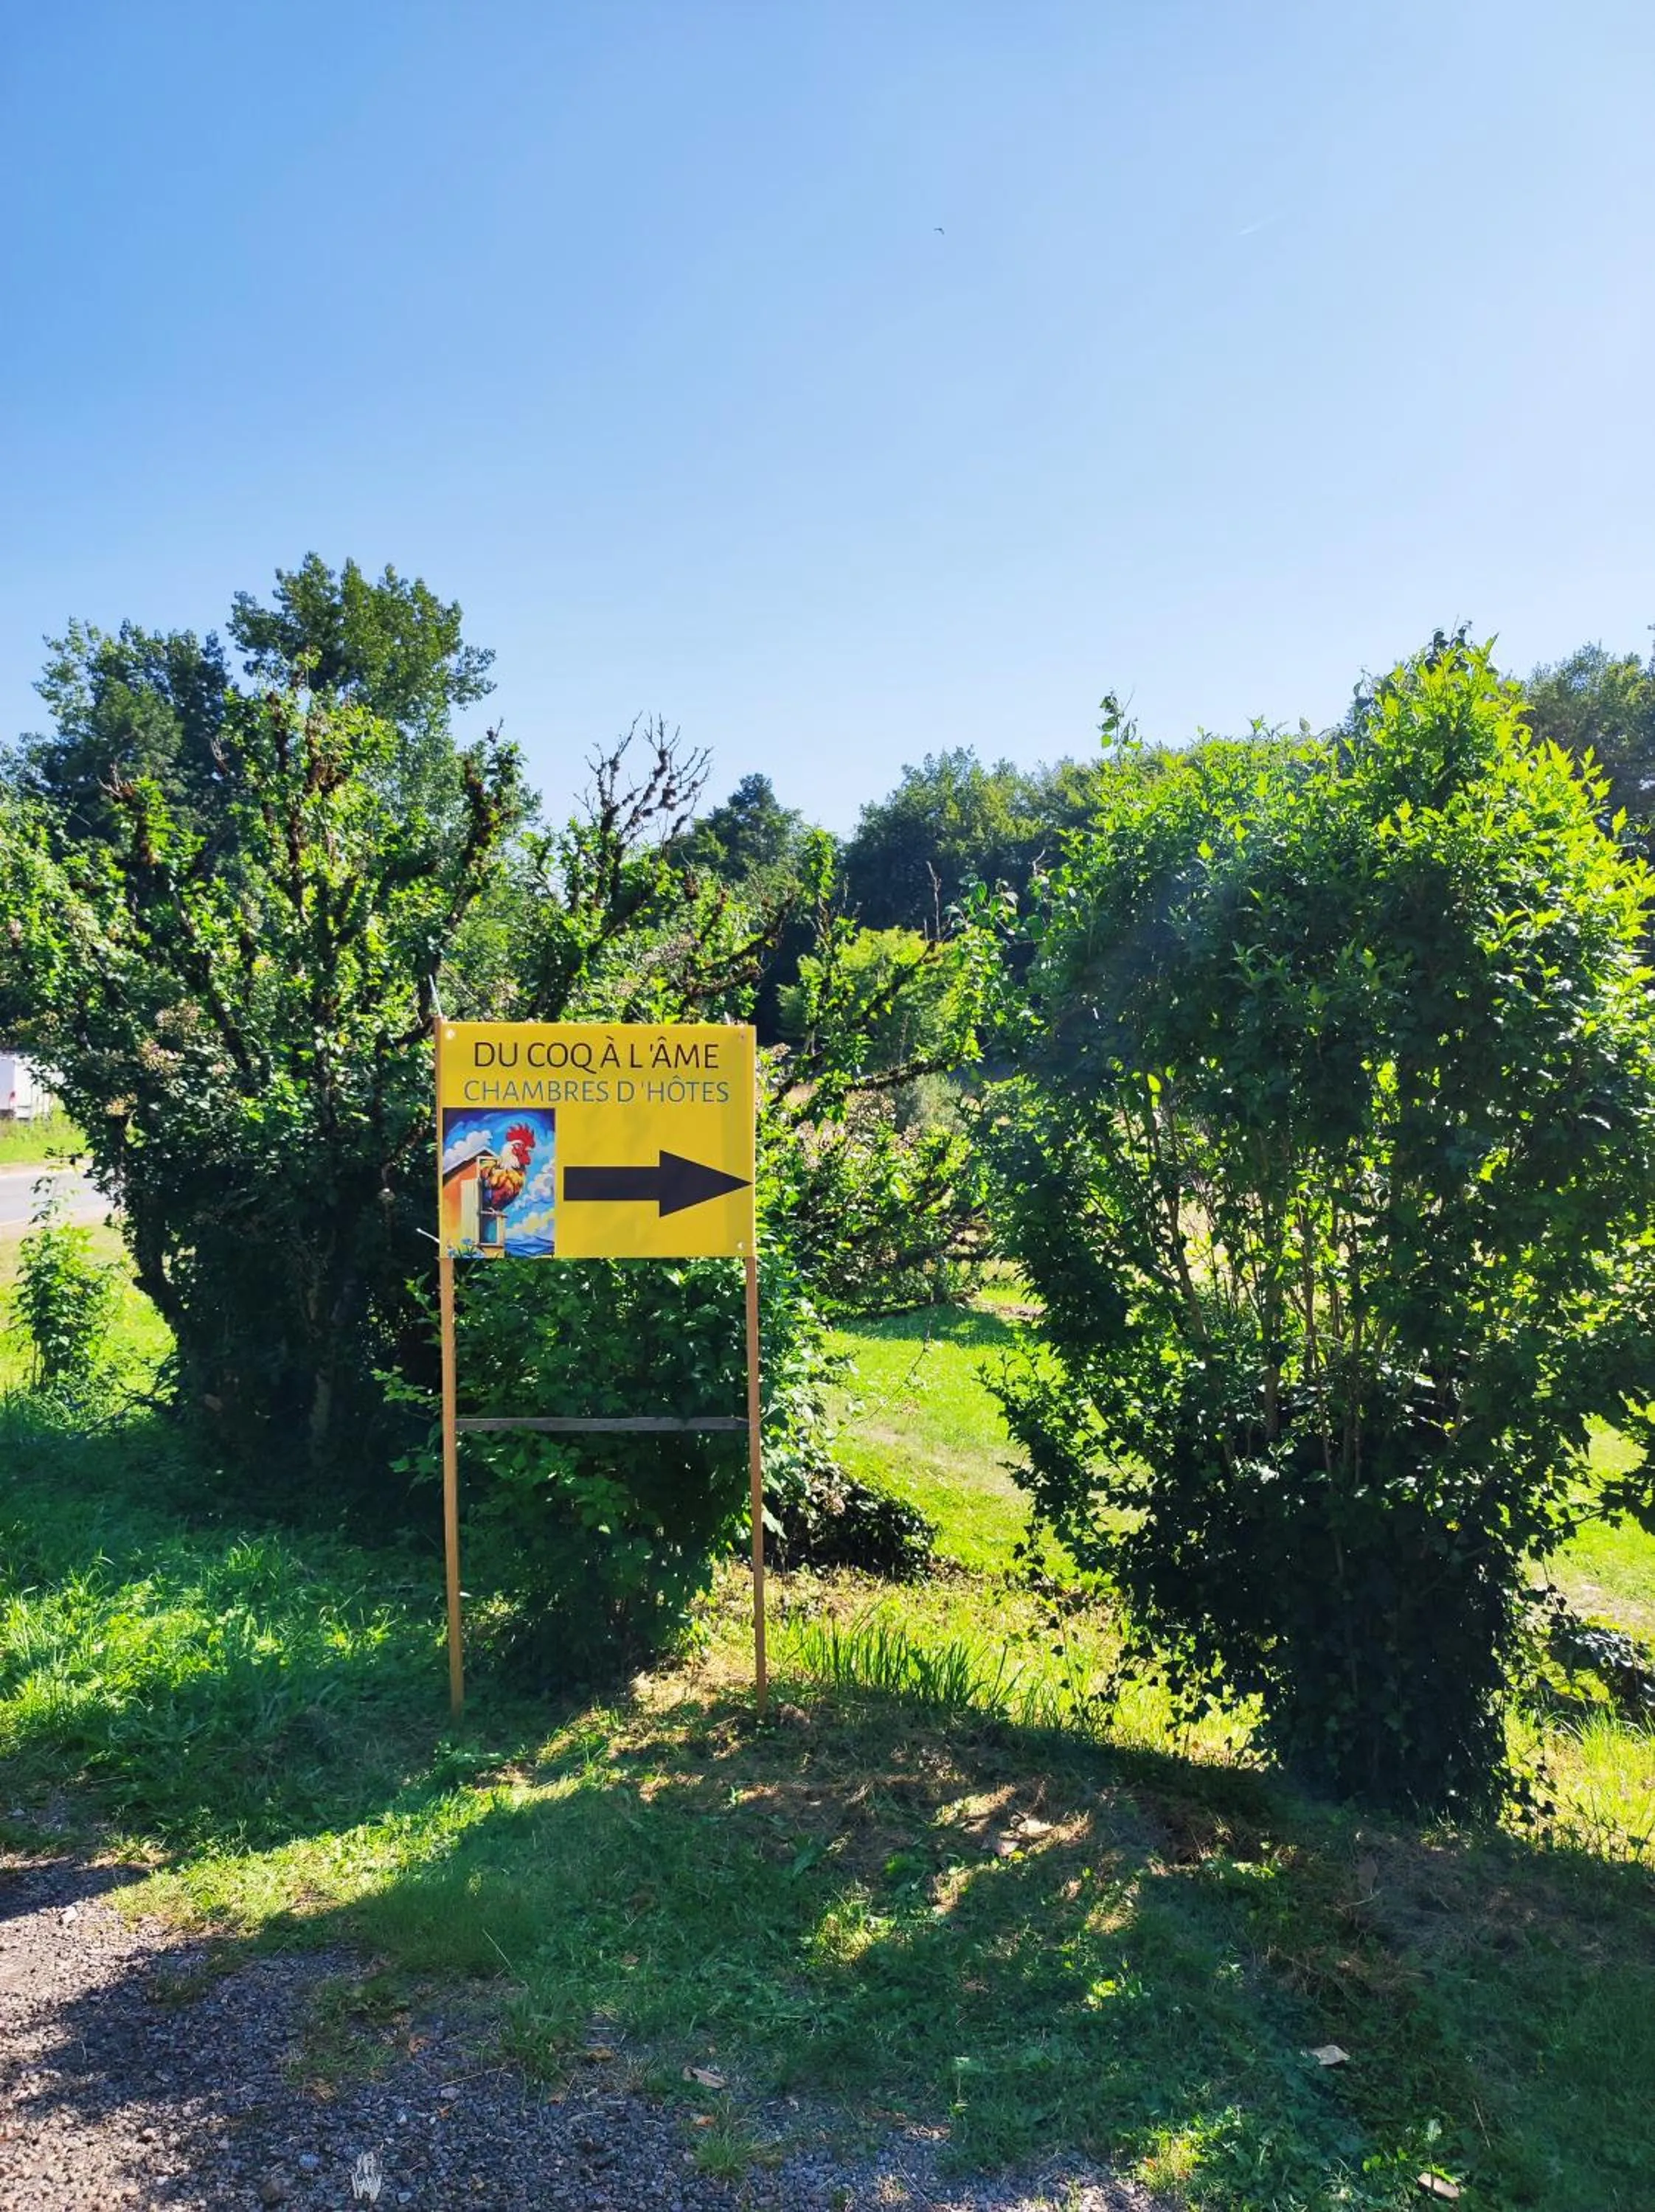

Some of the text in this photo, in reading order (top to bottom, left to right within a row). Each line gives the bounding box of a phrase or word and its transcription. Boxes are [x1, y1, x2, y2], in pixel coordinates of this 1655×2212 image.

[473, 1040, 519, 1069] DU
[527, 1040, 597, 1075] COQ
[600, 1035, 621, 1069] À
[463, 1079, 610, 1103] CHAMBRES
